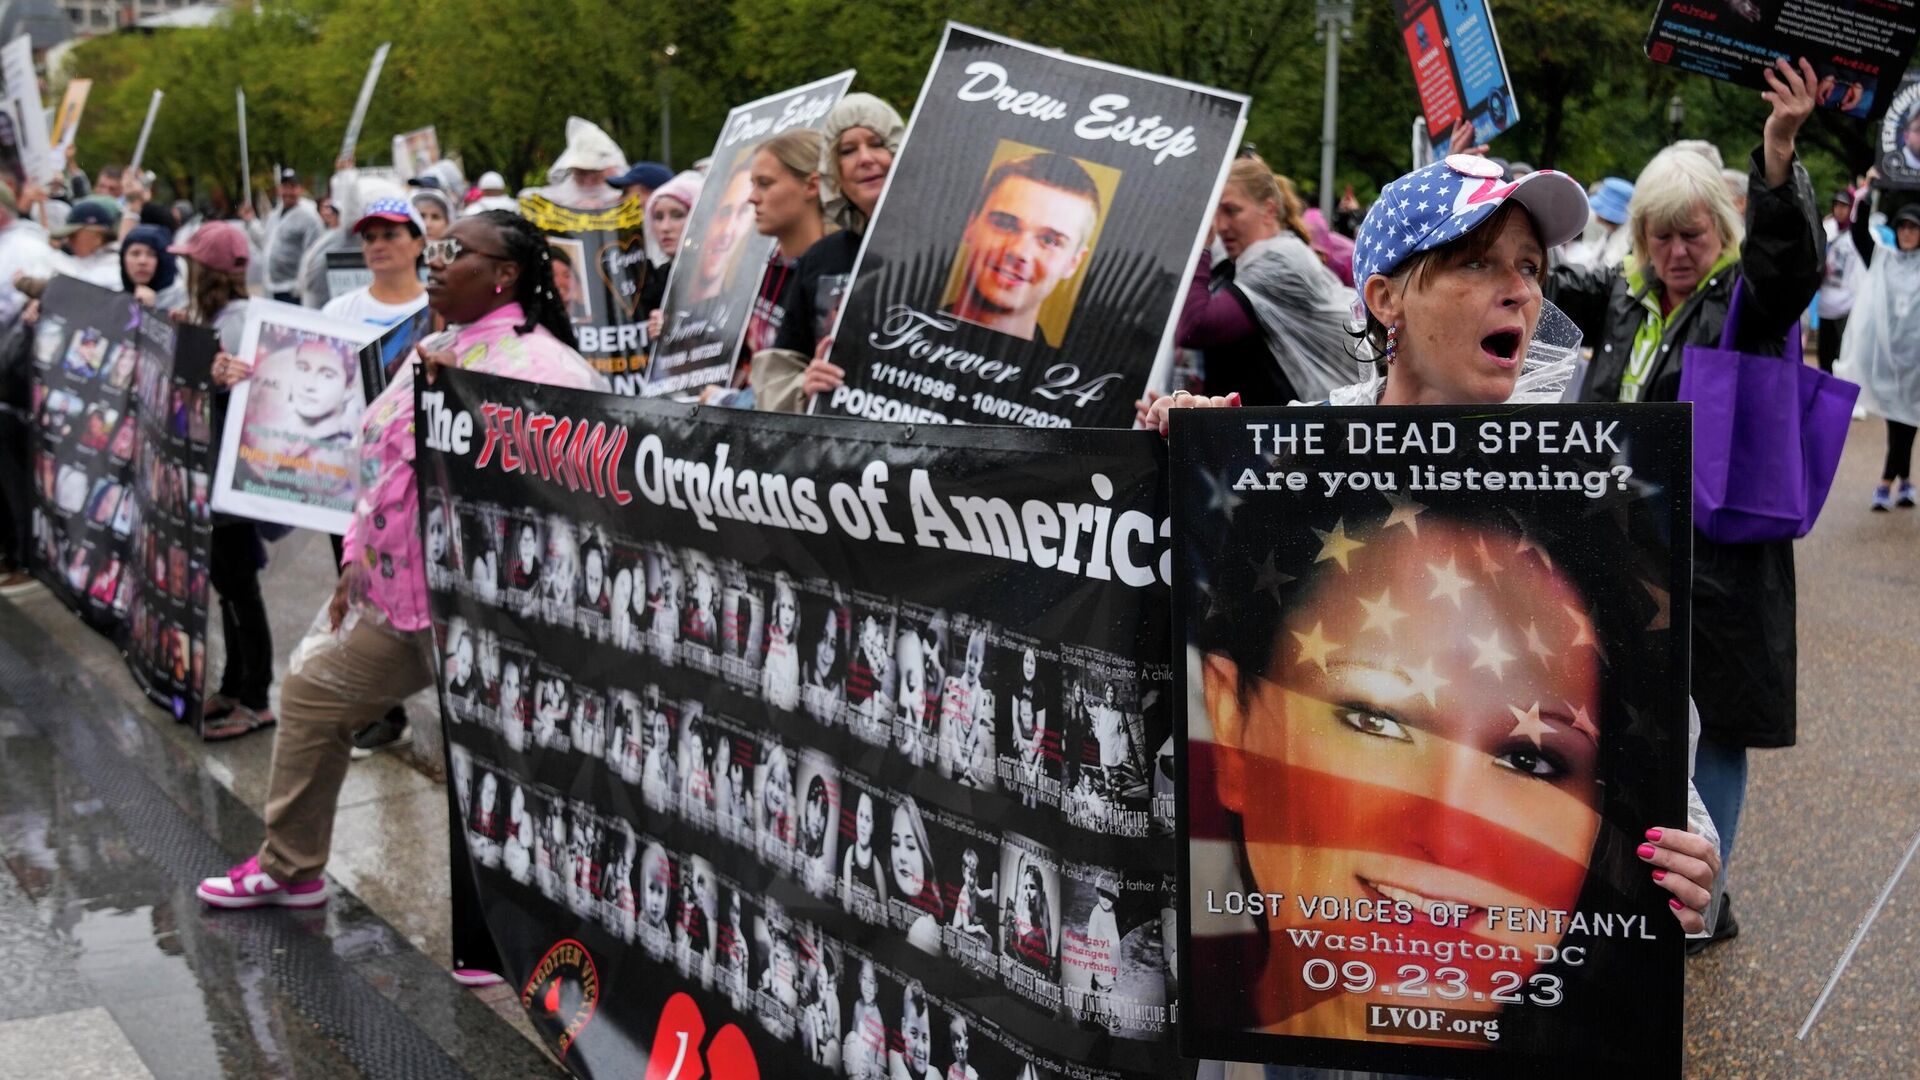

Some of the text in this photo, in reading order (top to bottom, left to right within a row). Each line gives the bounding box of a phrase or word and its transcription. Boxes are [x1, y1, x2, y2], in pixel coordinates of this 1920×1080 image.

[957, 60, 1198, 166] Drew Estep
[868, 303, 1126, 408] Forever 24
[870, 362, 956, 402] 1/11/1996
[1246, 420, 1621, 455] THE DEAD SPEAK
[421, 390, 474, 455] The
[474, 399, 633, 506] FENTANYL
[634, 433, 828, 535] Orphans
[828, 460, 905, 544] of
[1232, 464, 1633, 499] Are you listening?
[1060, 652, 1085, 667] Children
[1111, 667, 1137, 679] mother
[1111, 656, 1136, 668] children
[1141, 668, 1149, 680] A
[1096, 822, 1149, 837] OVERDOSE
[1066, 868, 1083, 881] child
[1126, 880, 1155, 892] father
[1206, 890, 1657, 940] LOST VOICES OF FENTANYL
[1064, 944, 1111, 960] changes
[1286, 928, 1587, 967] Washington DC
[1061, 955, 1118, 977] everything
[1302, 958, 1564, 1007] 09.23.23
[1370, 1006, 1500, 1041] LVOF.org
